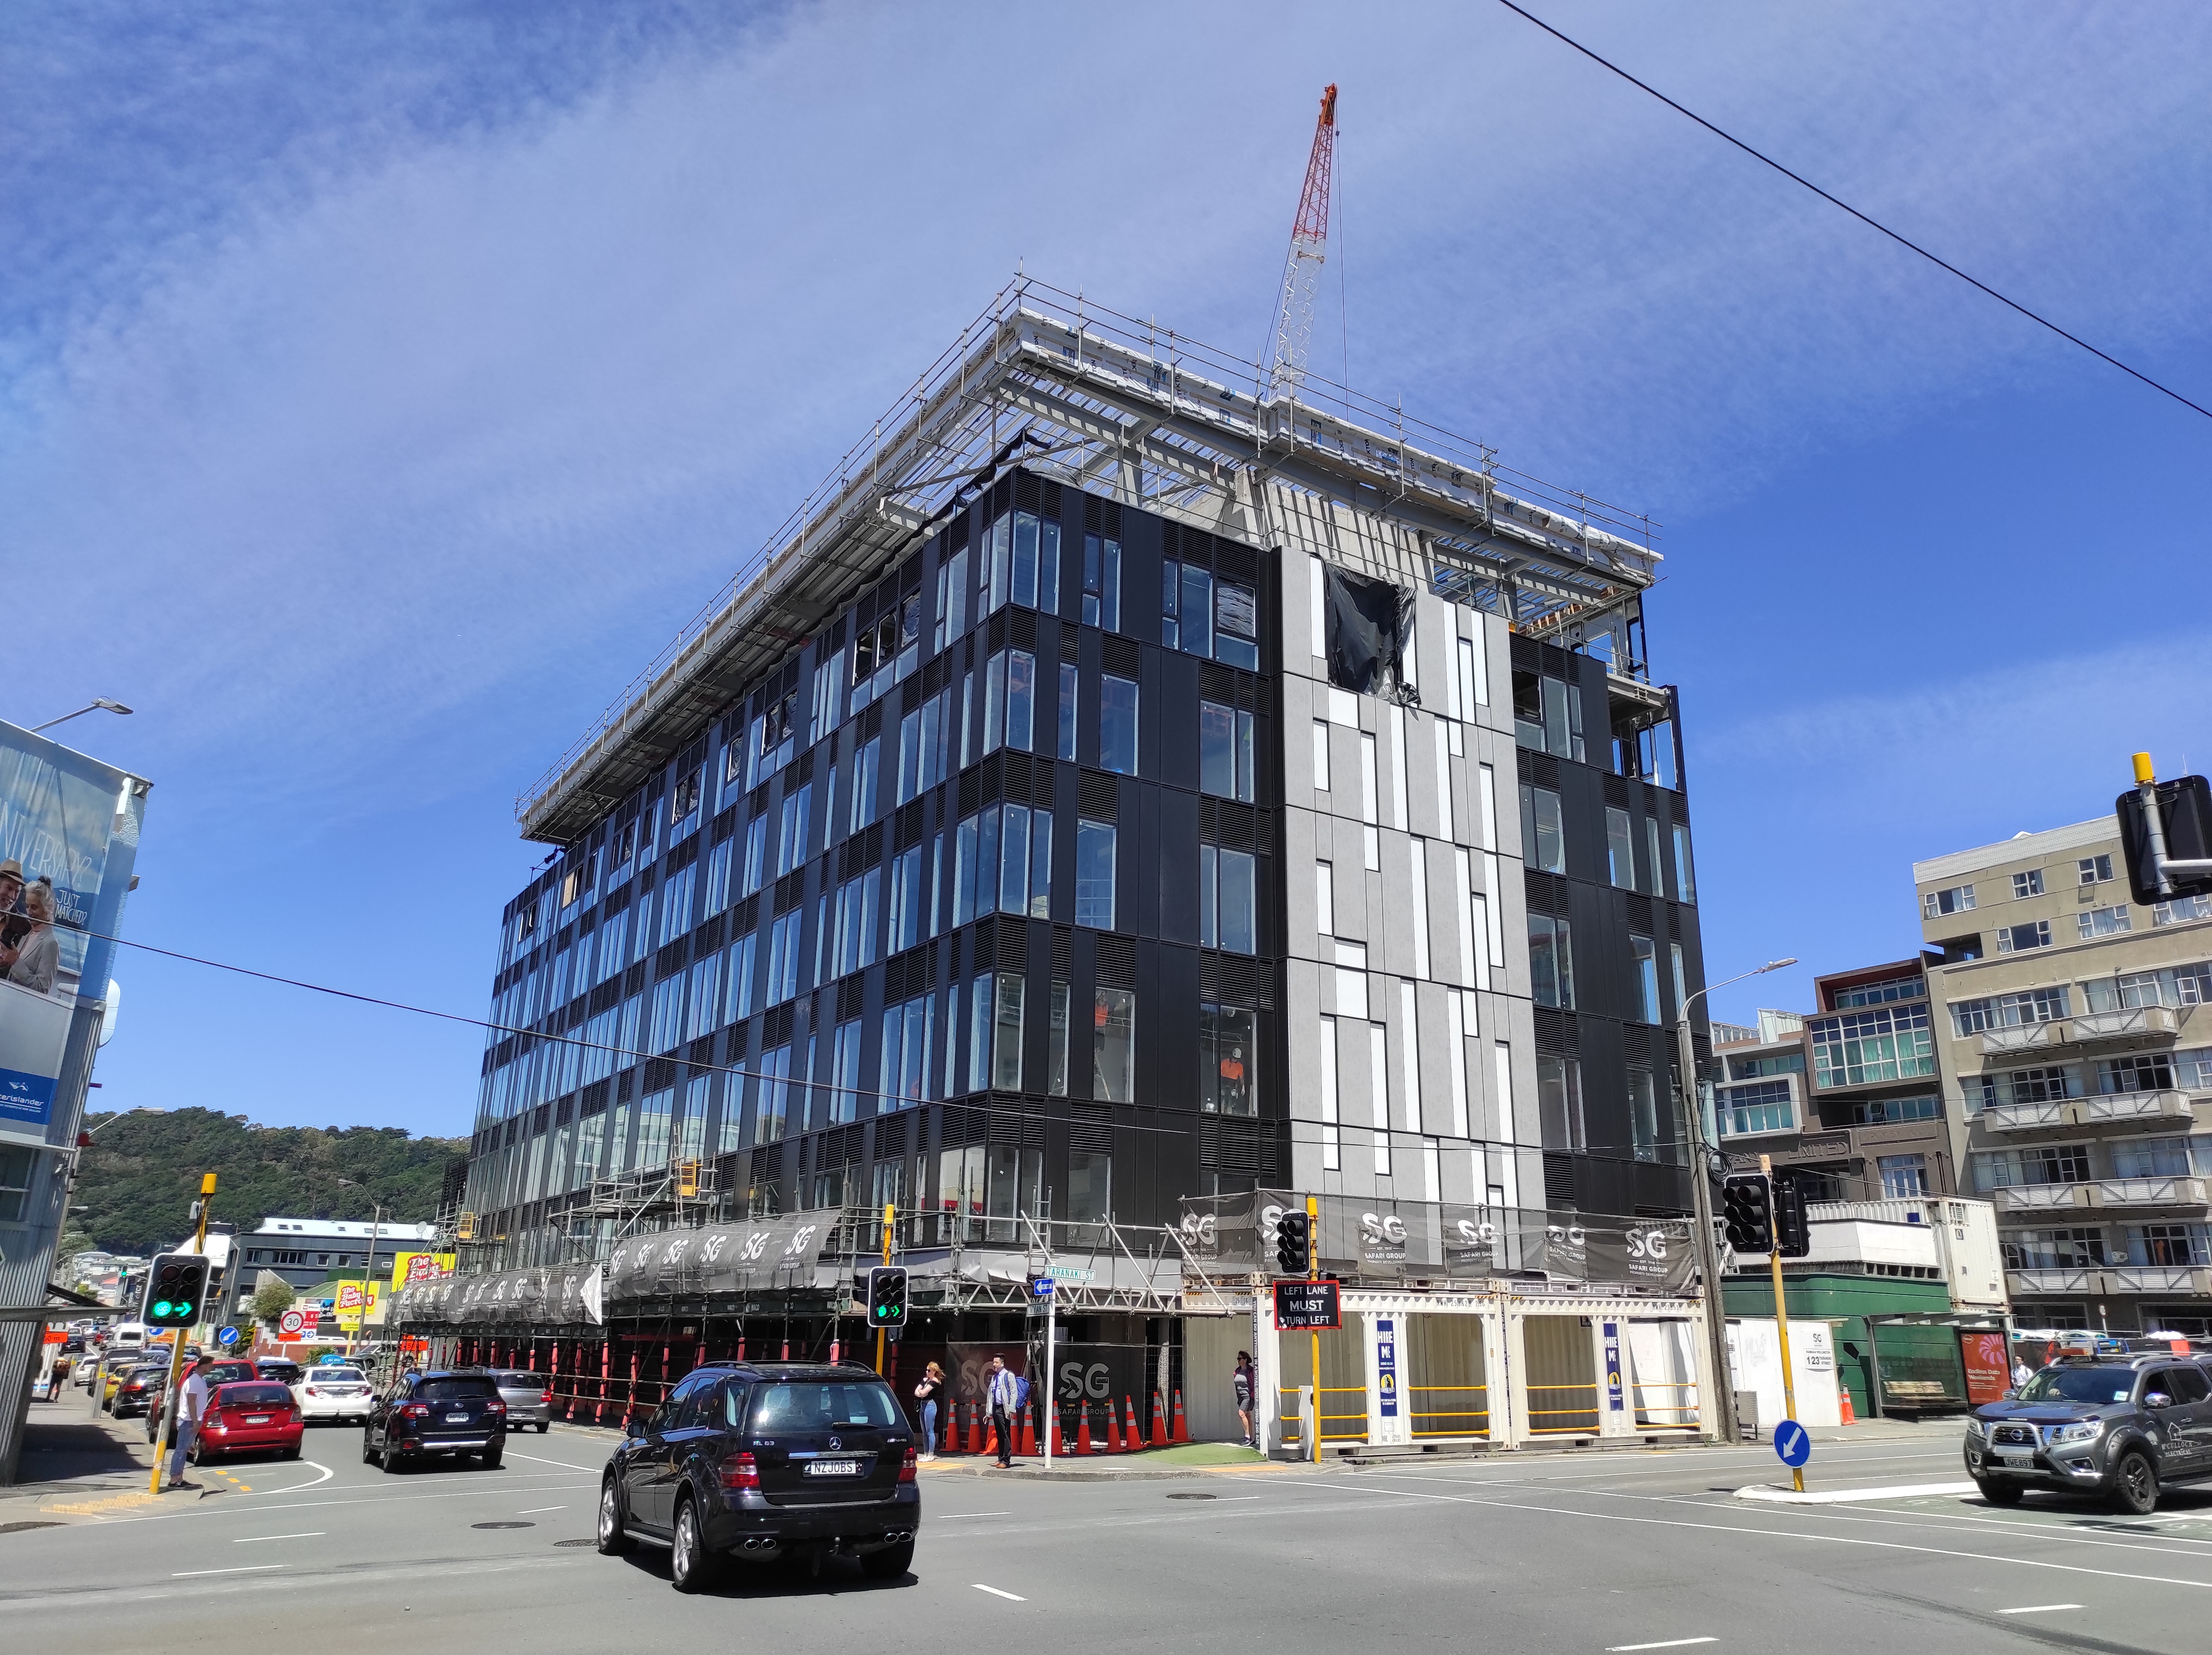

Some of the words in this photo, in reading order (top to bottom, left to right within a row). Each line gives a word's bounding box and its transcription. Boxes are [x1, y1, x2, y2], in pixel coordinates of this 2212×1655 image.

[56, 889, 81, 908] JUST
[55, 903, 88, 926] MATCHED?
[1182, 1213, 1217, 1246] SG
[1362, 1212, 1407, 1244] SG
[1457, 1219, 1498, 1246] SG
[739, 1232, 770, 1260] SG
[783, 1225, 816, 1256] SG
[1625, 1228, 1668, 1259] SG
[661, 1239, 689, 1264] SG
[699, 1235, 727, 1262] SG
[410, 1257, 430, 1268] The
[610, 1249, 627, 1275] SG
[633, 1243, 655, 1269] SG
[1568, 1251, 1587, 1261] GROUP
[1048, 1267, 1082, 1279] TARANAKI
[1085, 1271, 1094, 1280] ST
[512, 1278, 528, 1300] SG
[563, 1276, 577, 1300] SG
[1284, 1287, 1304, 1296] LEFT
[1306, 1286, 1329, 1295] LANE
[339, 1296, 373, 1308] Factoy
[341, 1292, 361, 1300] Baby
[1030, 1305, 1042, 1314] VIVIAN
[1043, 1304, 1048, 1313] ST
[1290, 1300, 1324, 1311] MUST
[286, 1318, 299, 1327] 30
[1254, 1323, 1258, 1331] DO
[1285, 1316, 1306, 1325] TURN
[1310, 1315, 1330, 1325] LEFT
[1377, 1330, 1393, 1344] HIRE
[1813, 1333, 1822, 1343] SG
[1381, 1345, 1391, 1359] ME
[1807, 1356, 1820, 1365] 123
[1058, 1361, 1109, 1399] SG
[2164, 1449, 2192, 1458] ELECTRICAL
[814, 1461, 853, 1473] NZJOBS
